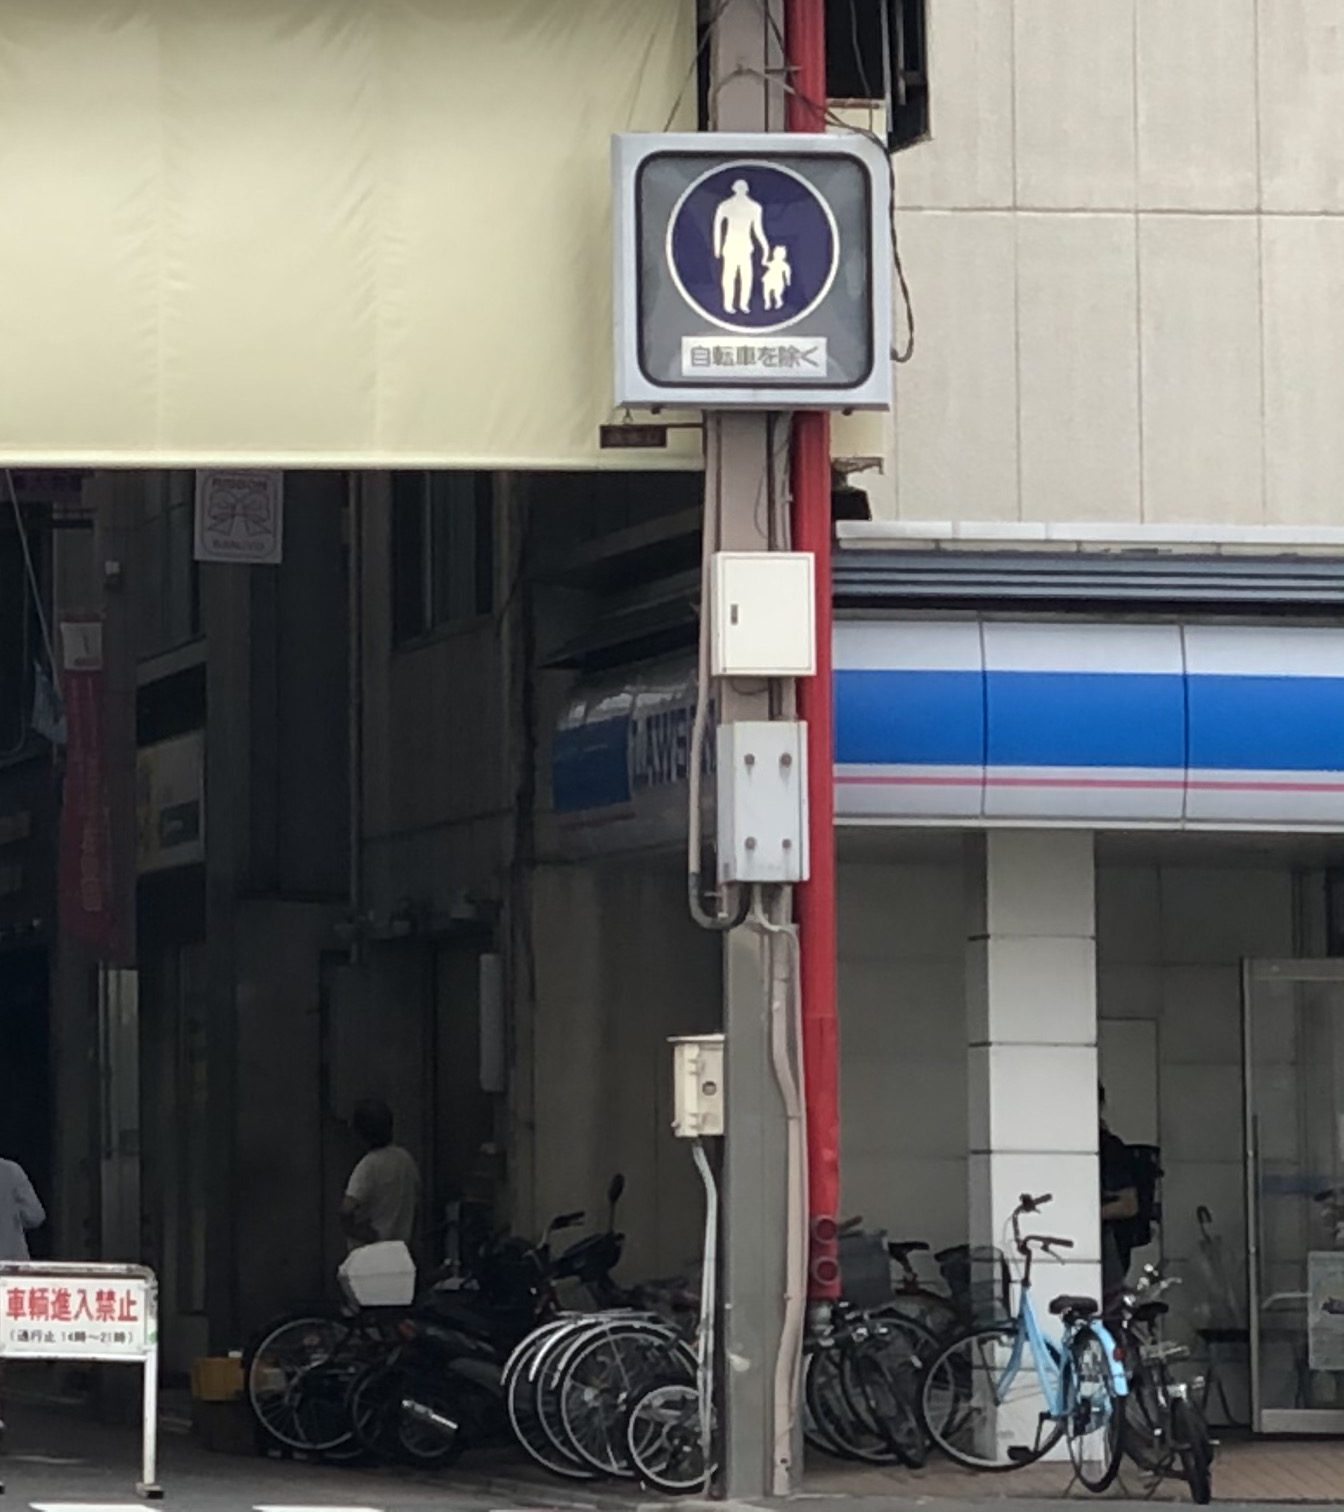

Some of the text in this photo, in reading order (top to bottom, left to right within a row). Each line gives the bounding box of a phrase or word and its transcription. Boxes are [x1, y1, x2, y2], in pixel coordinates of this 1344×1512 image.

[690, 344, 819, 368] 自転車を除く
